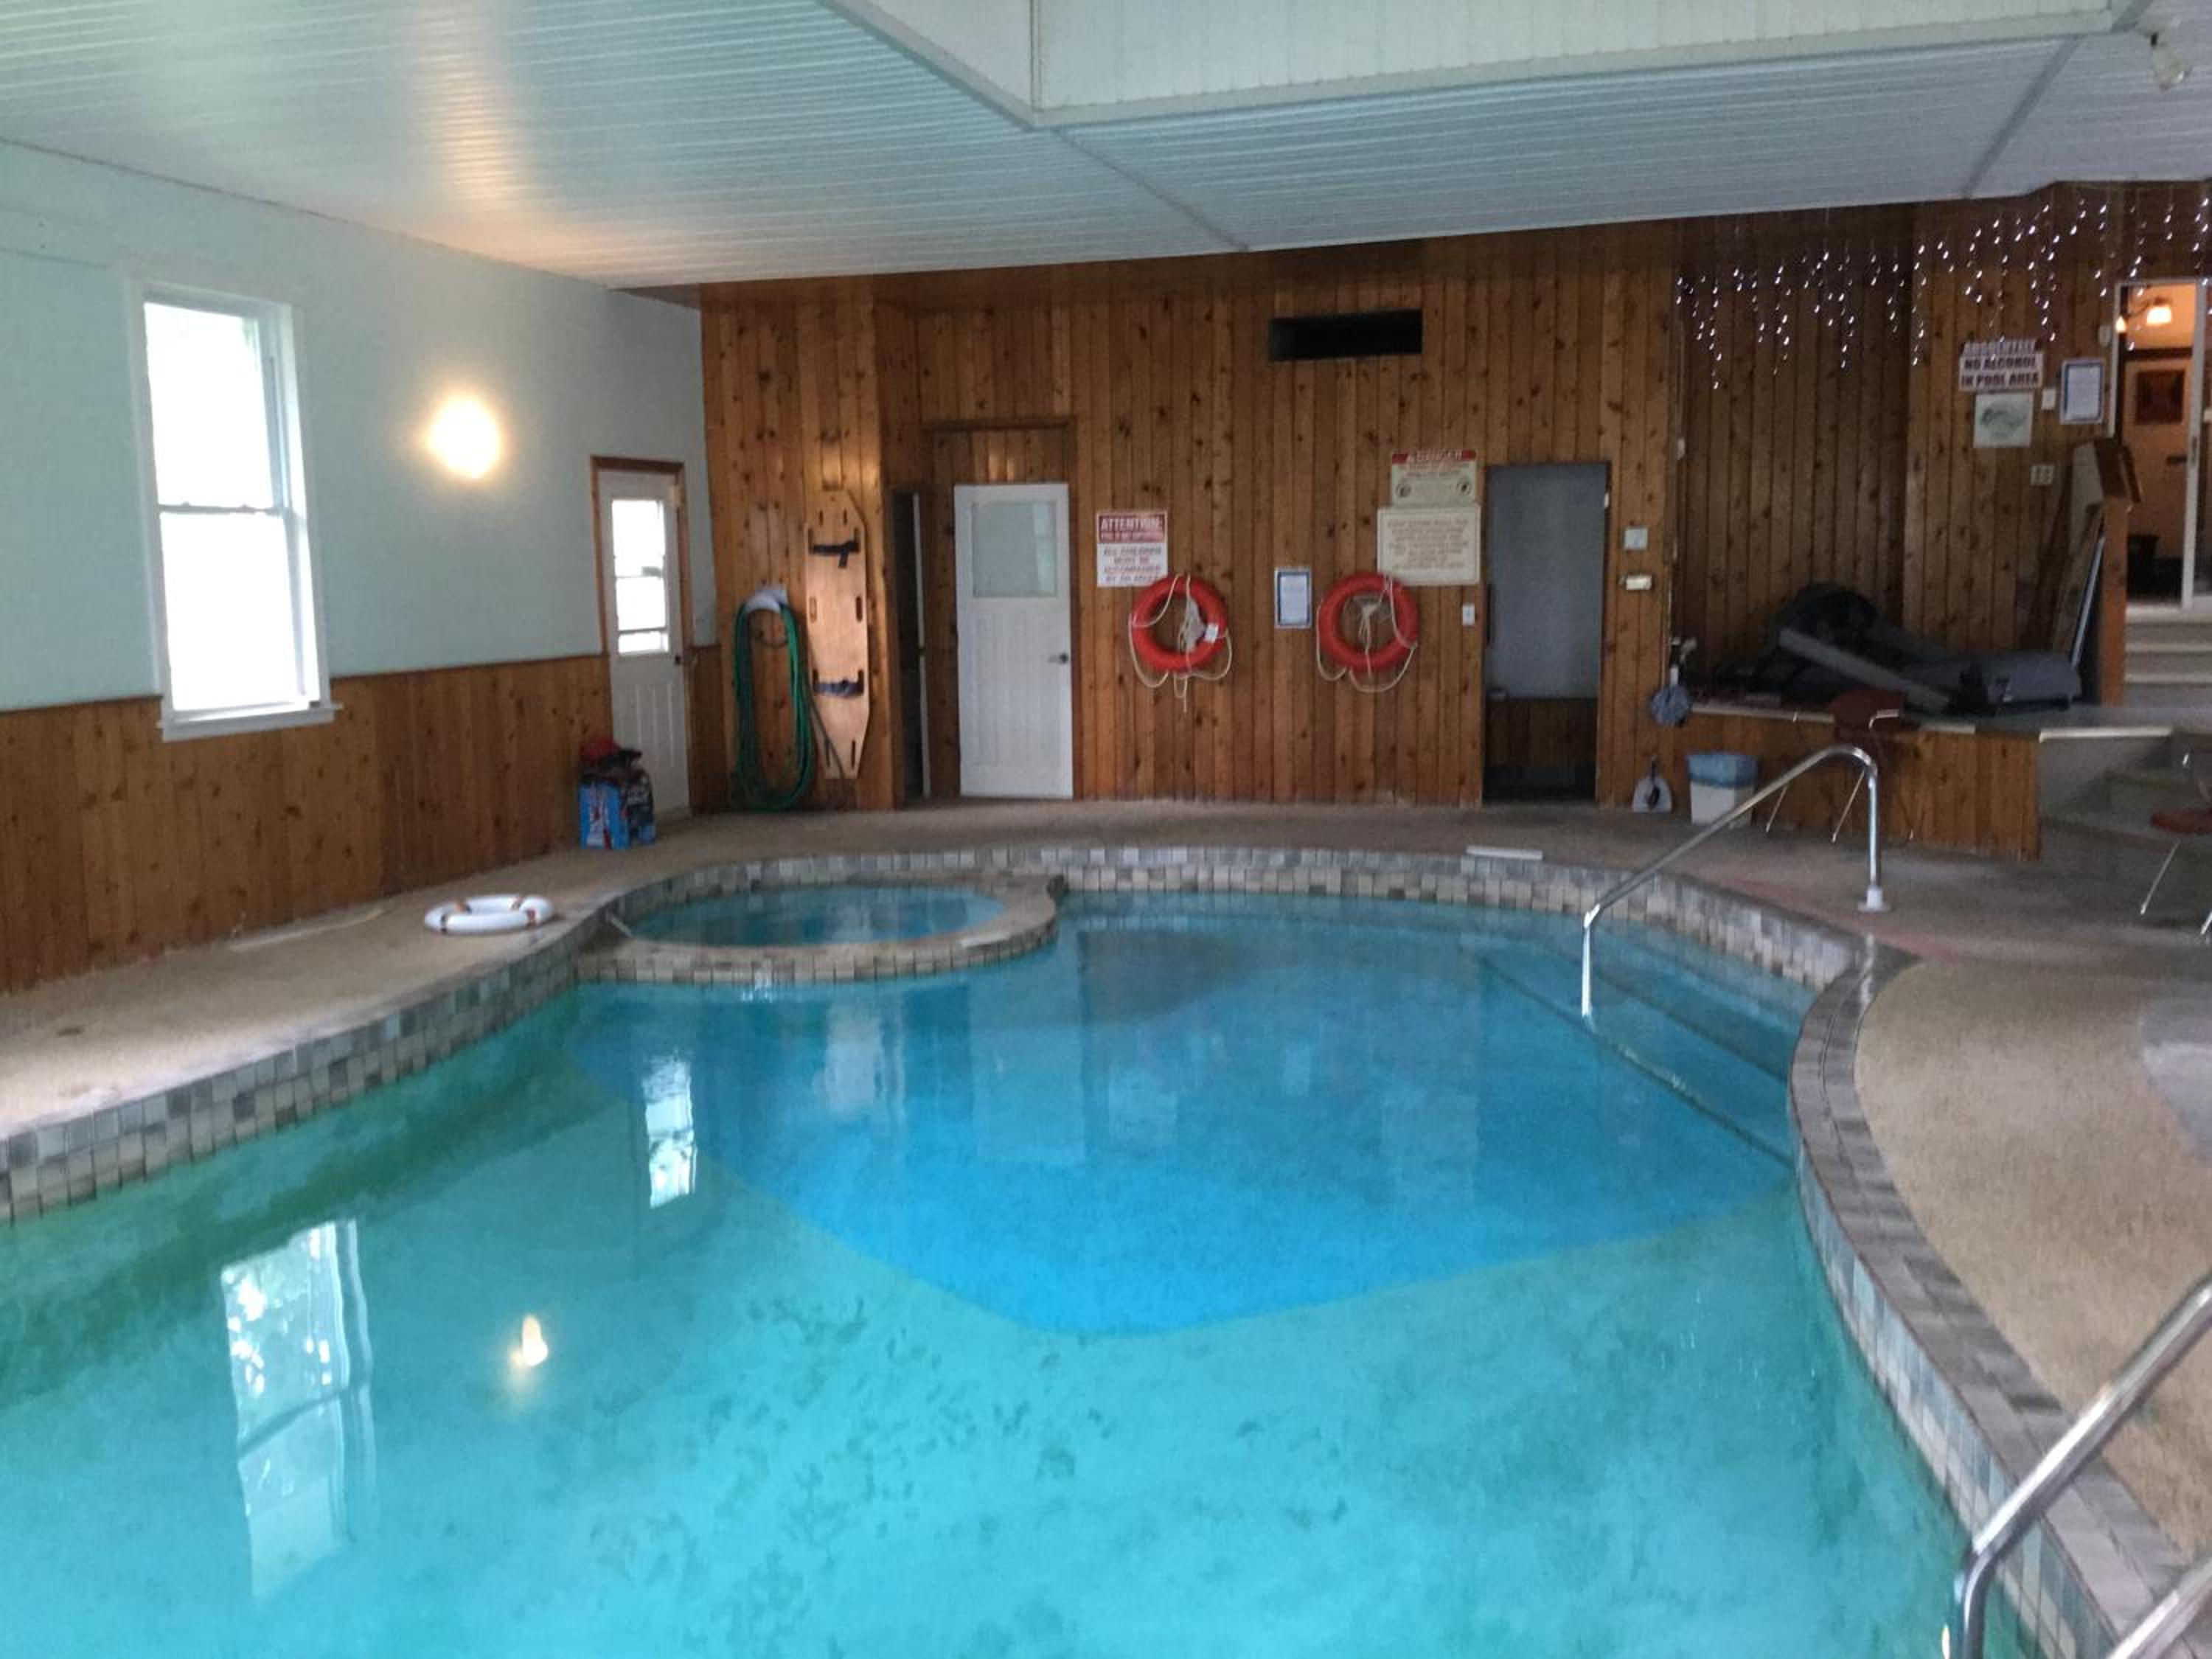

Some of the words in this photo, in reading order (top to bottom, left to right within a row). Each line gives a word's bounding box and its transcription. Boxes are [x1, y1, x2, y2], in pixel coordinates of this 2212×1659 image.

[1964, 358, 1981, 370] NO
[1983, 357, 2036, 369] ALCOHOL
[1961, 375, 1973, 386] IN
[1976, 374, 2005, 386] POOL
[2008, 372, 2039, 385] AREA
